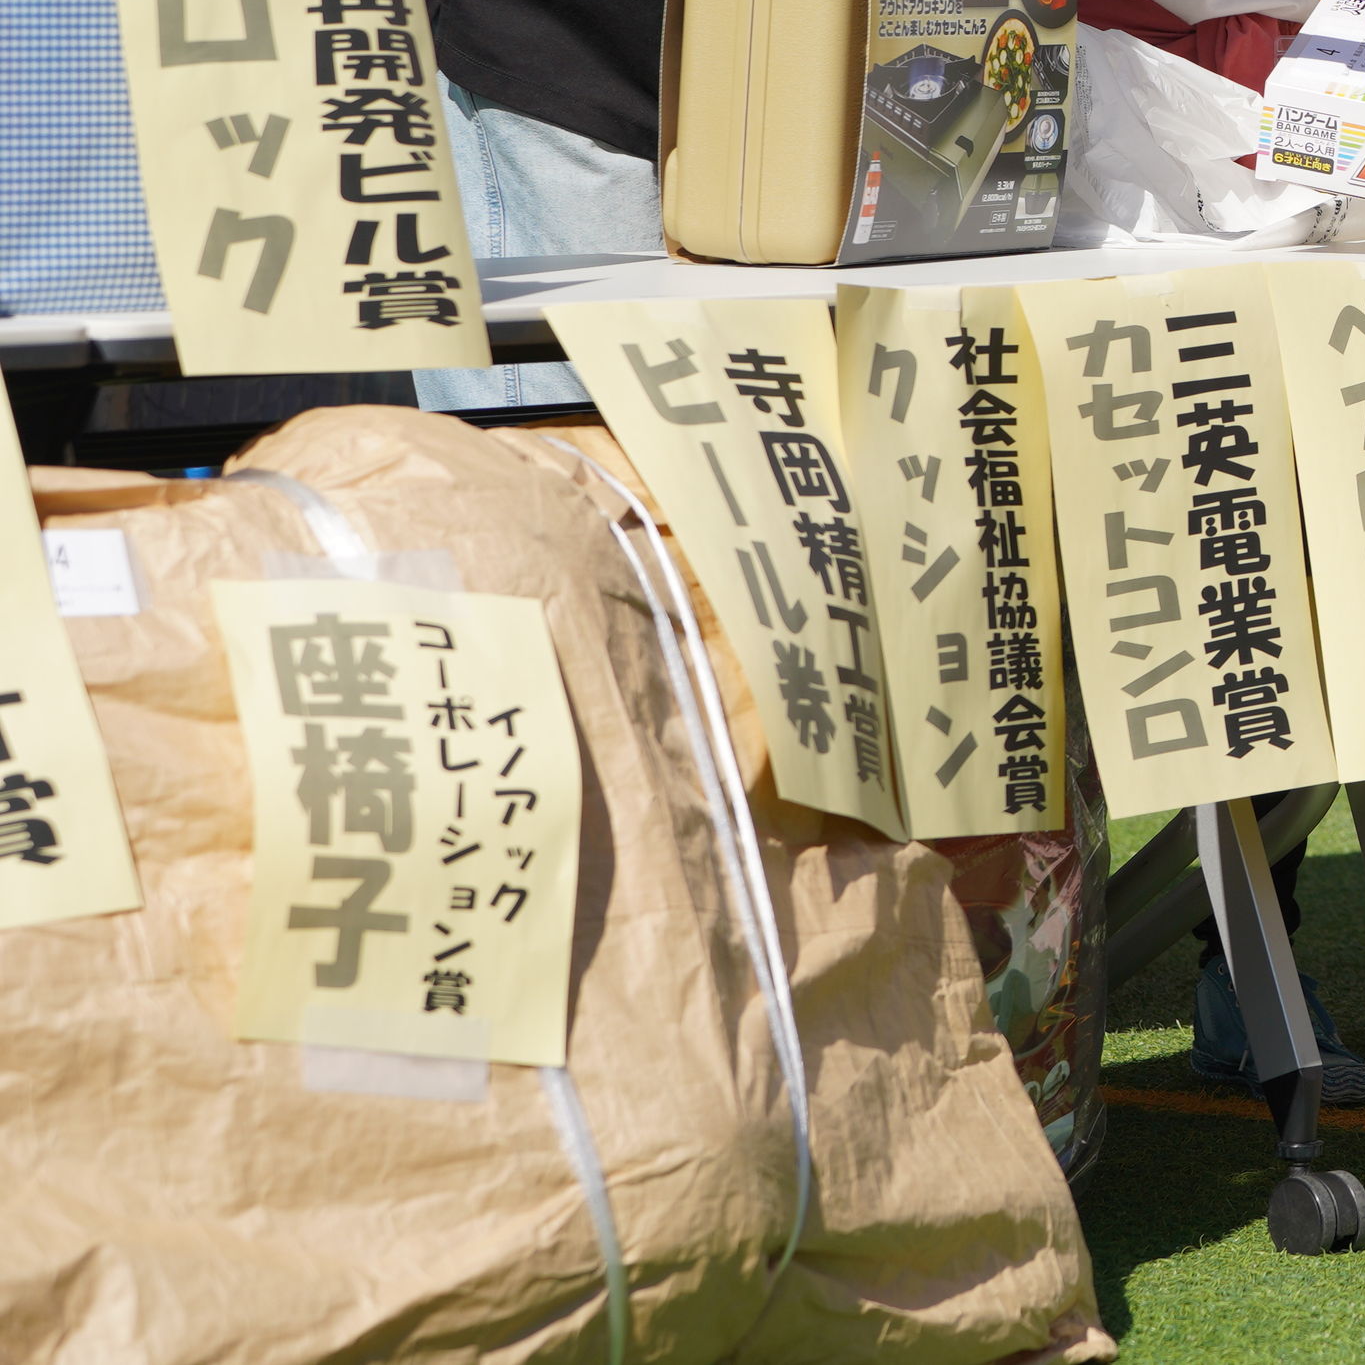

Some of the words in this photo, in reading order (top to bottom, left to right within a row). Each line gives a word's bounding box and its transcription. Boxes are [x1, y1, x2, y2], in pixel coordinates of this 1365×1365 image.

[879, 19, 987, 37] とことん楽しむカセットこんろ
[1274, 152, 1332, 172] 6才以上向き
[1276, 121, 1301, 134] BAN
[1304, 126, 1337, 141] GAME
[621, 336, 839, 755] ビール券
[724, 347, 888, 795] 寺岡精工賞
[867, 342, 980, 789] クッション
[945, 326, 1051, 816] 社会福祉協議会賞
[1065, 319, 1209, 761] カセットコンロ
[1165, 310, 1296, 760] 三英電業賞
[268, 612, 417, 990] 座椅子
[411, 620, 479, 1016] コーポレーション賞
[486, 706, 539, 925] イノアック
